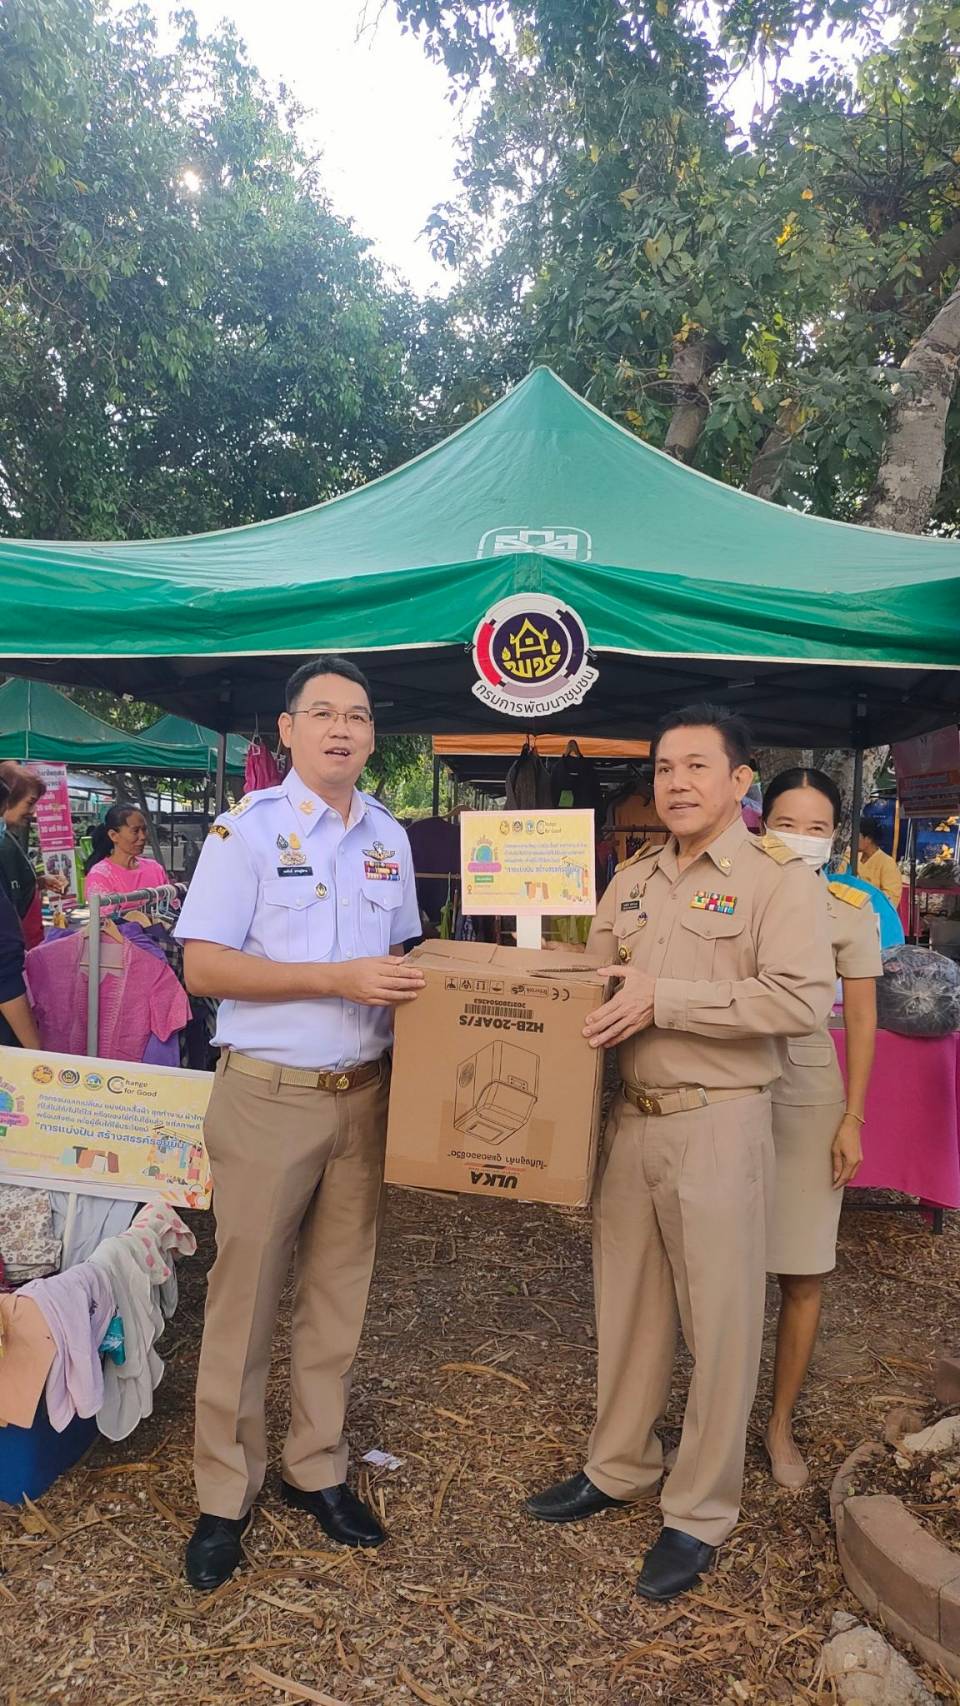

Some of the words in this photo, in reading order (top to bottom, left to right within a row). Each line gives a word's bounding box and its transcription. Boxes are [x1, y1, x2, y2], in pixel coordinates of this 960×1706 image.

[476, 670, 595, 714] กรมการพัฒนาชุมชน
[459, 1015, 544, 1033] HZB-20AF/S
[124, 1087, 134, 1095] for
[470, 1171, 518, 1189] ULKA
